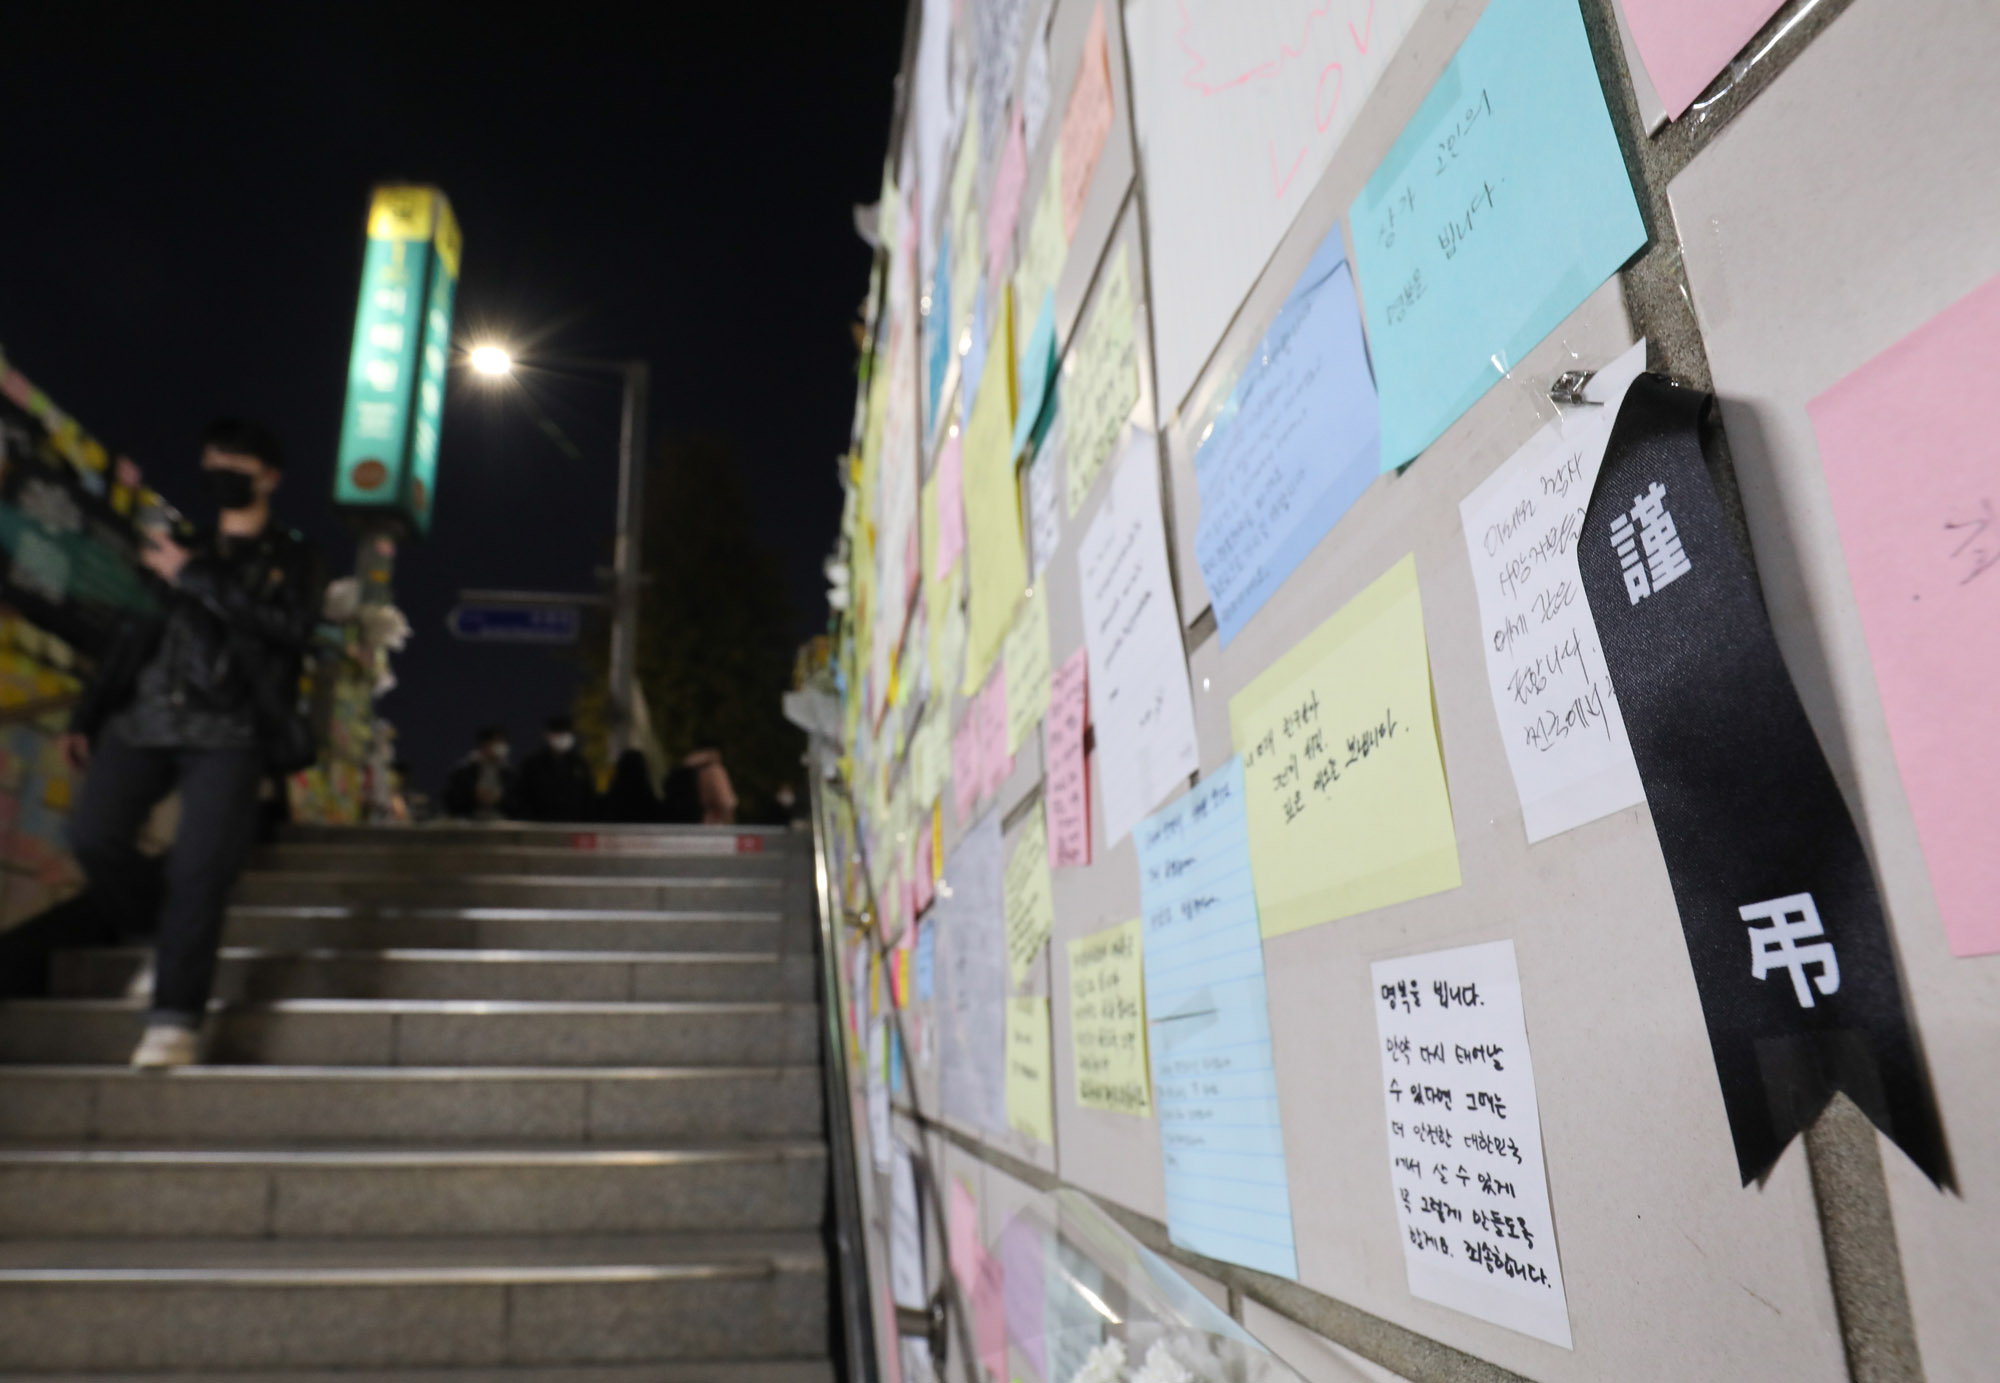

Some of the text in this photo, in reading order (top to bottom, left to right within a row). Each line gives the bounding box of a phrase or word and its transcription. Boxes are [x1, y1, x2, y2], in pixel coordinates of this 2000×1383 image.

[1436, 88, 1492, 176] 고인의
[1386, 177, 1505, 325] 명복을 빕니다.
[1610, 481, 1840, 1008] 謹 弔
[1381, 979, 1485, 1013] 명복을 빕니다.
[1387, 1036, 1504, 1071] 만약 다시 태어날
[1389, 1078, 1507, 1119] 수 있다면 그때는
[1392, 1120, 1522, 1164] 더 안전한 대한민국
[1395, 1157, 1516, 1199] 에서 살 수 있게
[1420, 1196, 1462, 1224] 그렇게
[1472, 1210, 1534, 1249] 만들도록
[1464, 1239, 1551, 1288] 죄송합니다.
